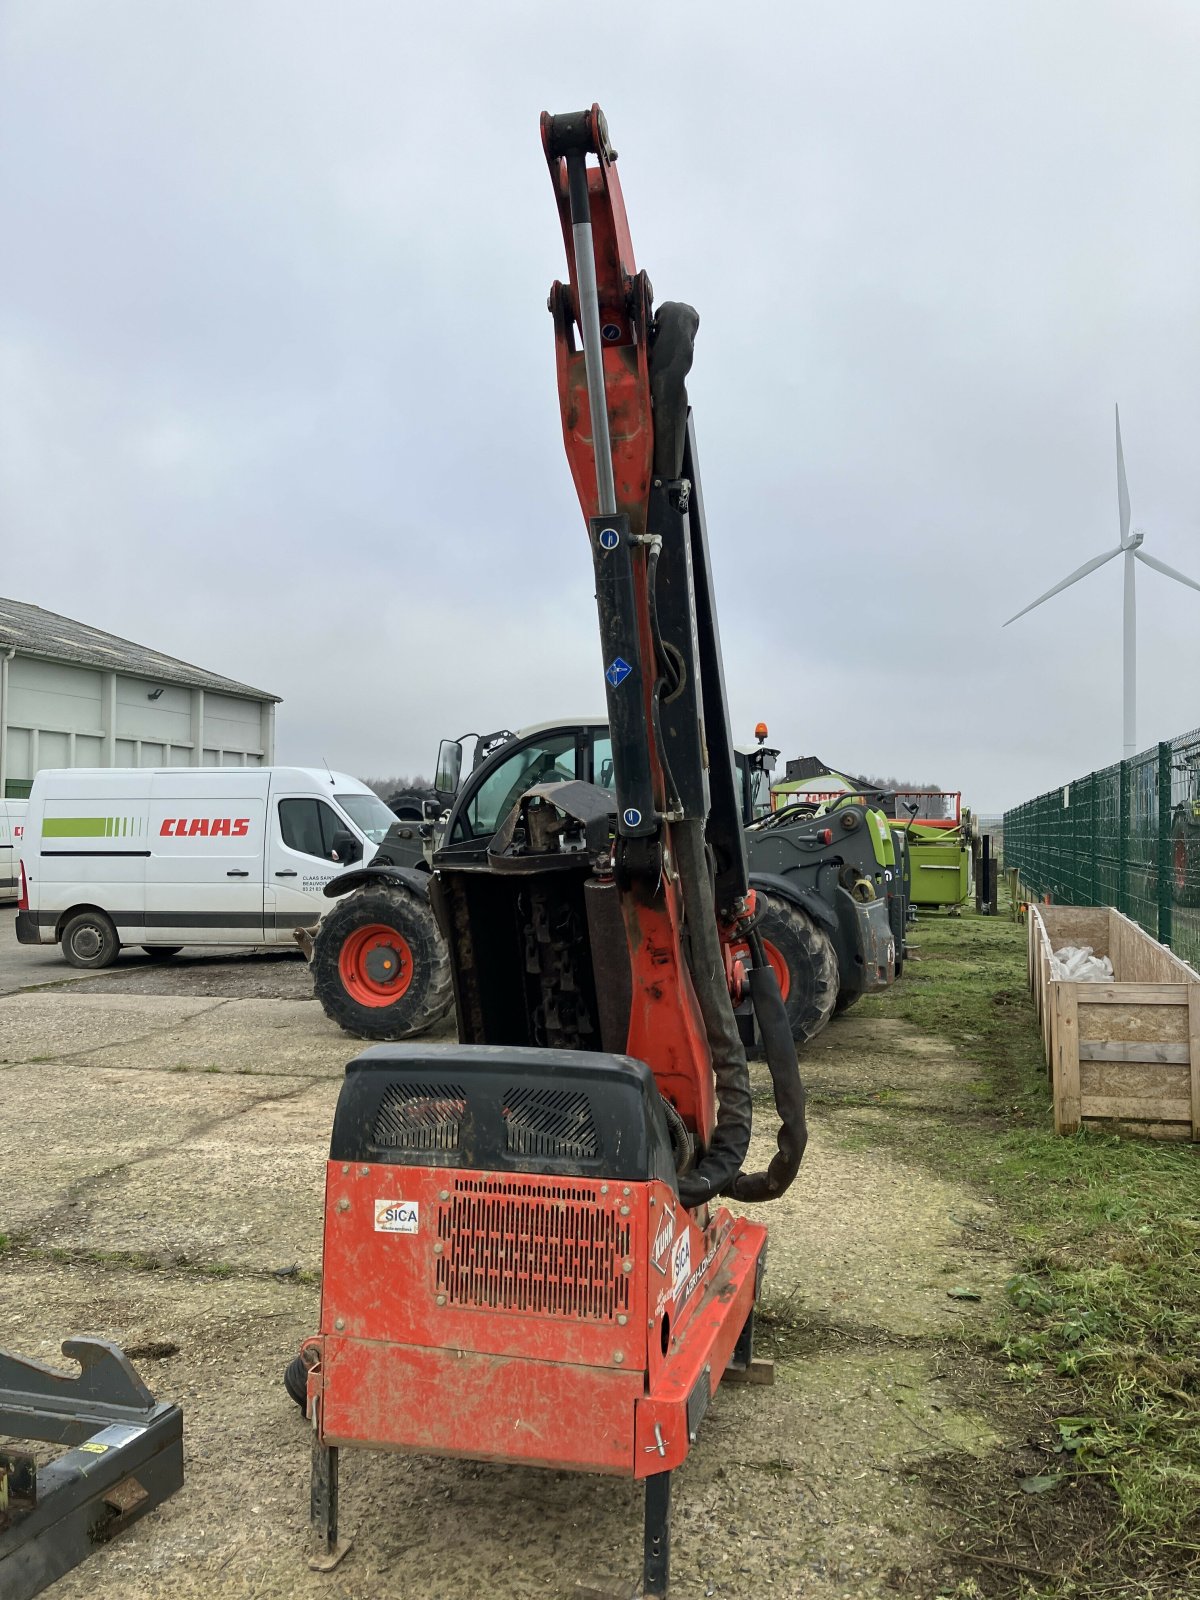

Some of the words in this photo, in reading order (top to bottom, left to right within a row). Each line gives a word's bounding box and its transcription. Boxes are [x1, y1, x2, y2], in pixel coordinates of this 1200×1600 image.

[160, 819, 250, 836] CLAAS
[385, 1209, 418, 1222] SICA
[655, 1219, 674, 1262] KUHN
[675, 1242, 689, 1276] SICA
